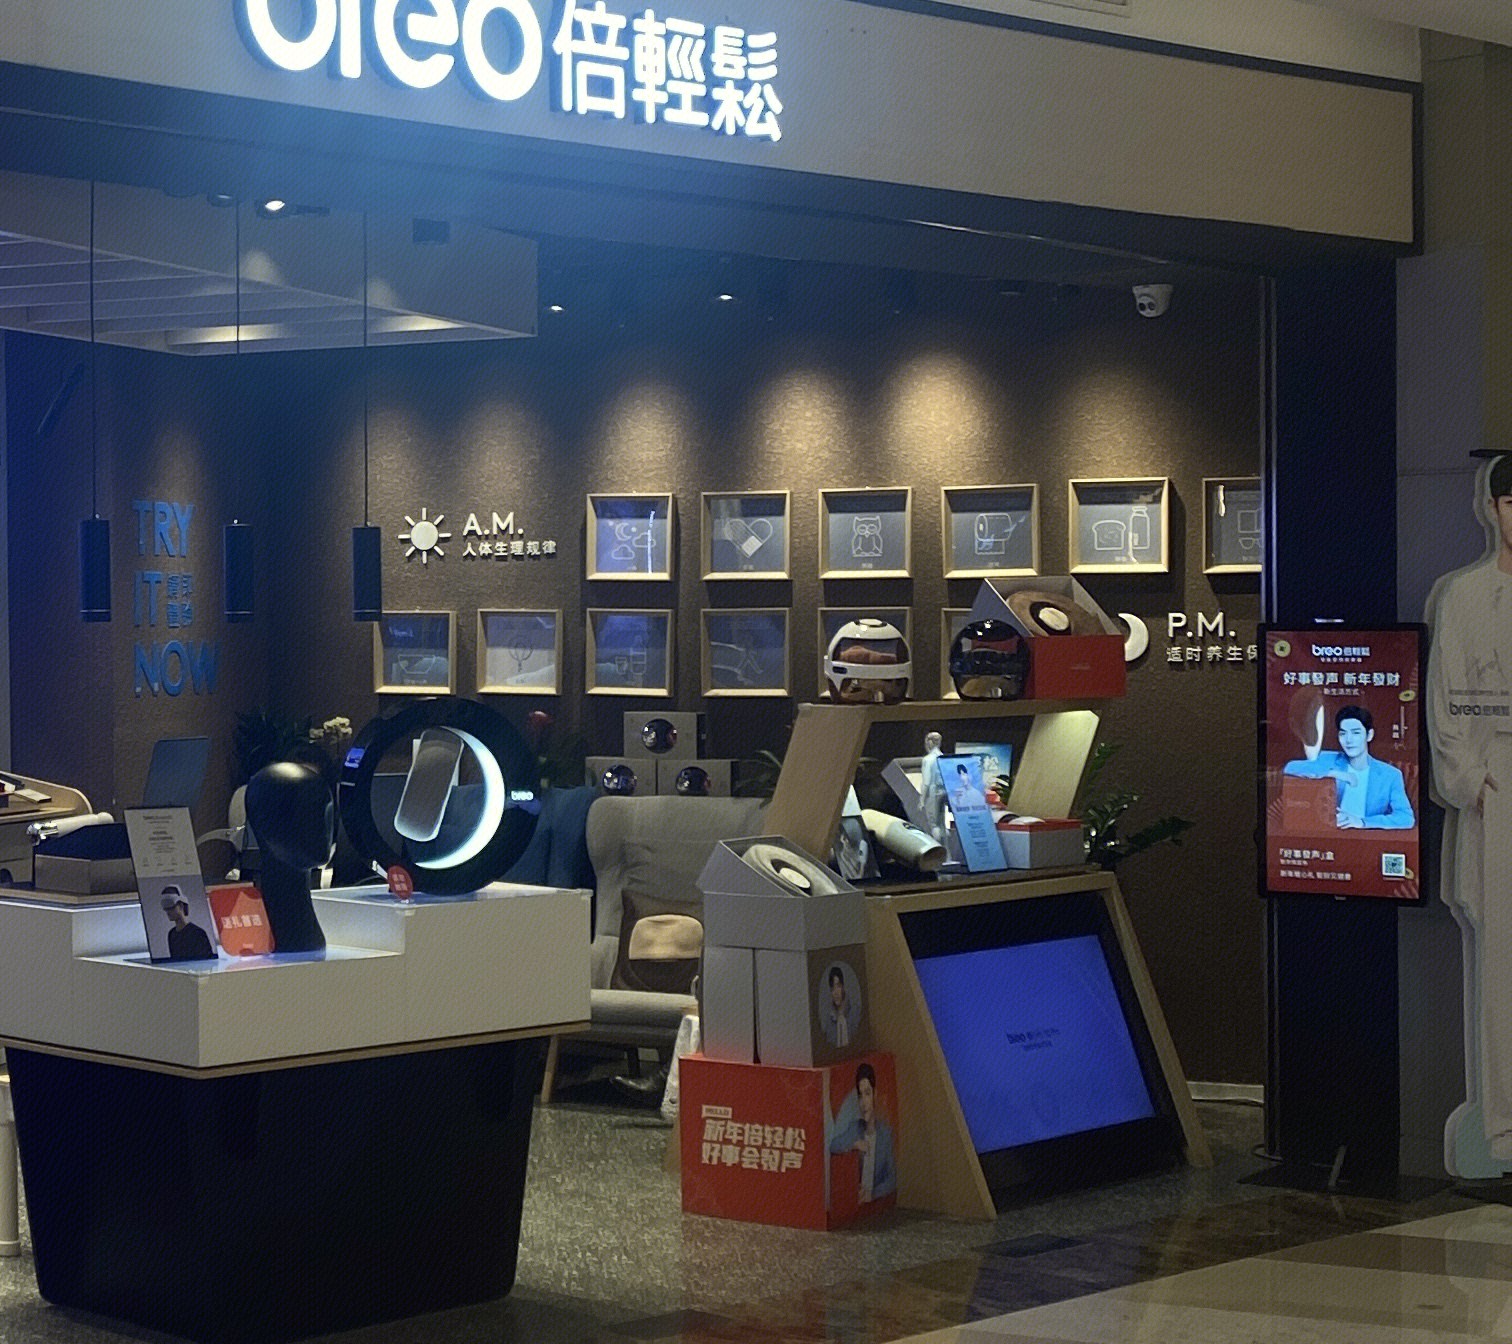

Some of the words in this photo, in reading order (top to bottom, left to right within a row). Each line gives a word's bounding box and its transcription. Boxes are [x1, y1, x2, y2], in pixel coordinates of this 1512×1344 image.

[133, 501, 194, 557] TRY
[462, 540, 557, 557] 人体生理规律
[133, 570, 163, 627] IT
[1168, 611, 1237, 638] P.M.
[1311, 643, 1343, 657] breo
[133, 640, 221, 698] NOW
[703, 1119, 807, 1151] 新年倍轻松
